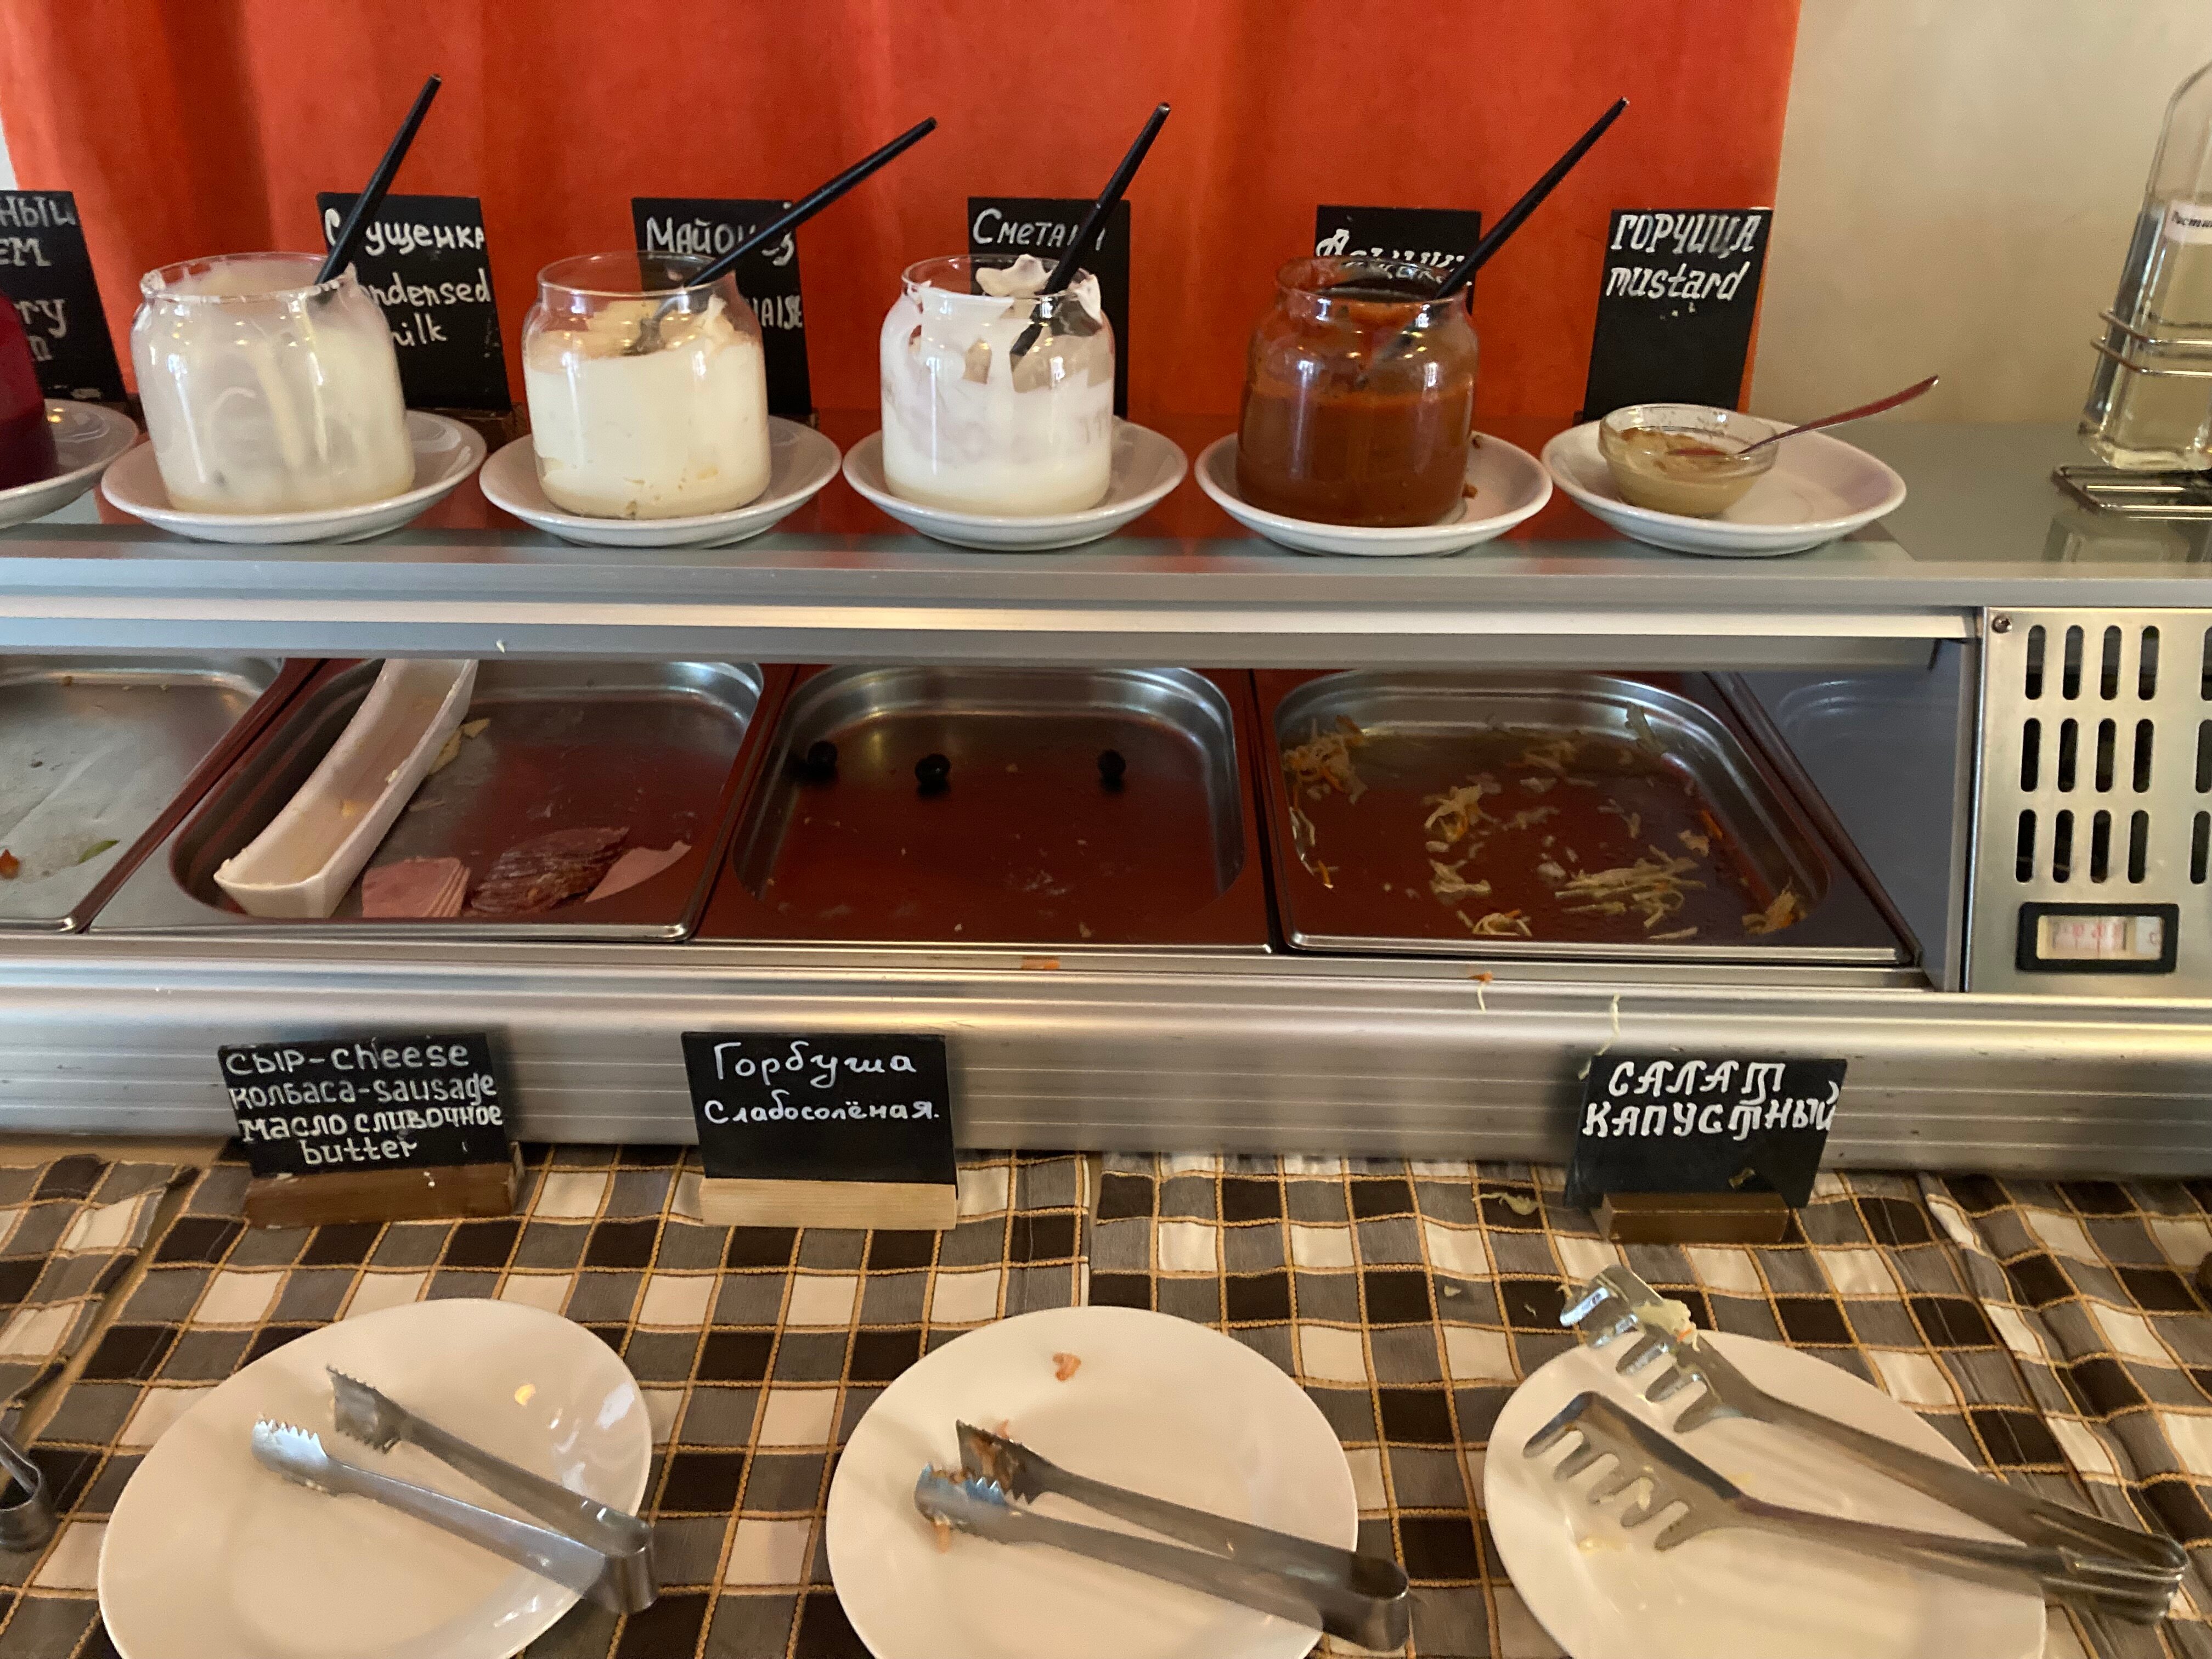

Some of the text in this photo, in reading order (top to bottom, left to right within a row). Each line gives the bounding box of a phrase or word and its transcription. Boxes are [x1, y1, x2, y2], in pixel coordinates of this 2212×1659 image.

[365, 267, 492, 307] ndensed
[1606, 261, 1751, 301] mustard
[390, 312, 448, 347] ilk
[714, 1040, 917, 1088] Горбуша
[1608, 1060, 1786, 1105] САЛАТ
[300, 1136, 417, 1165] butter
